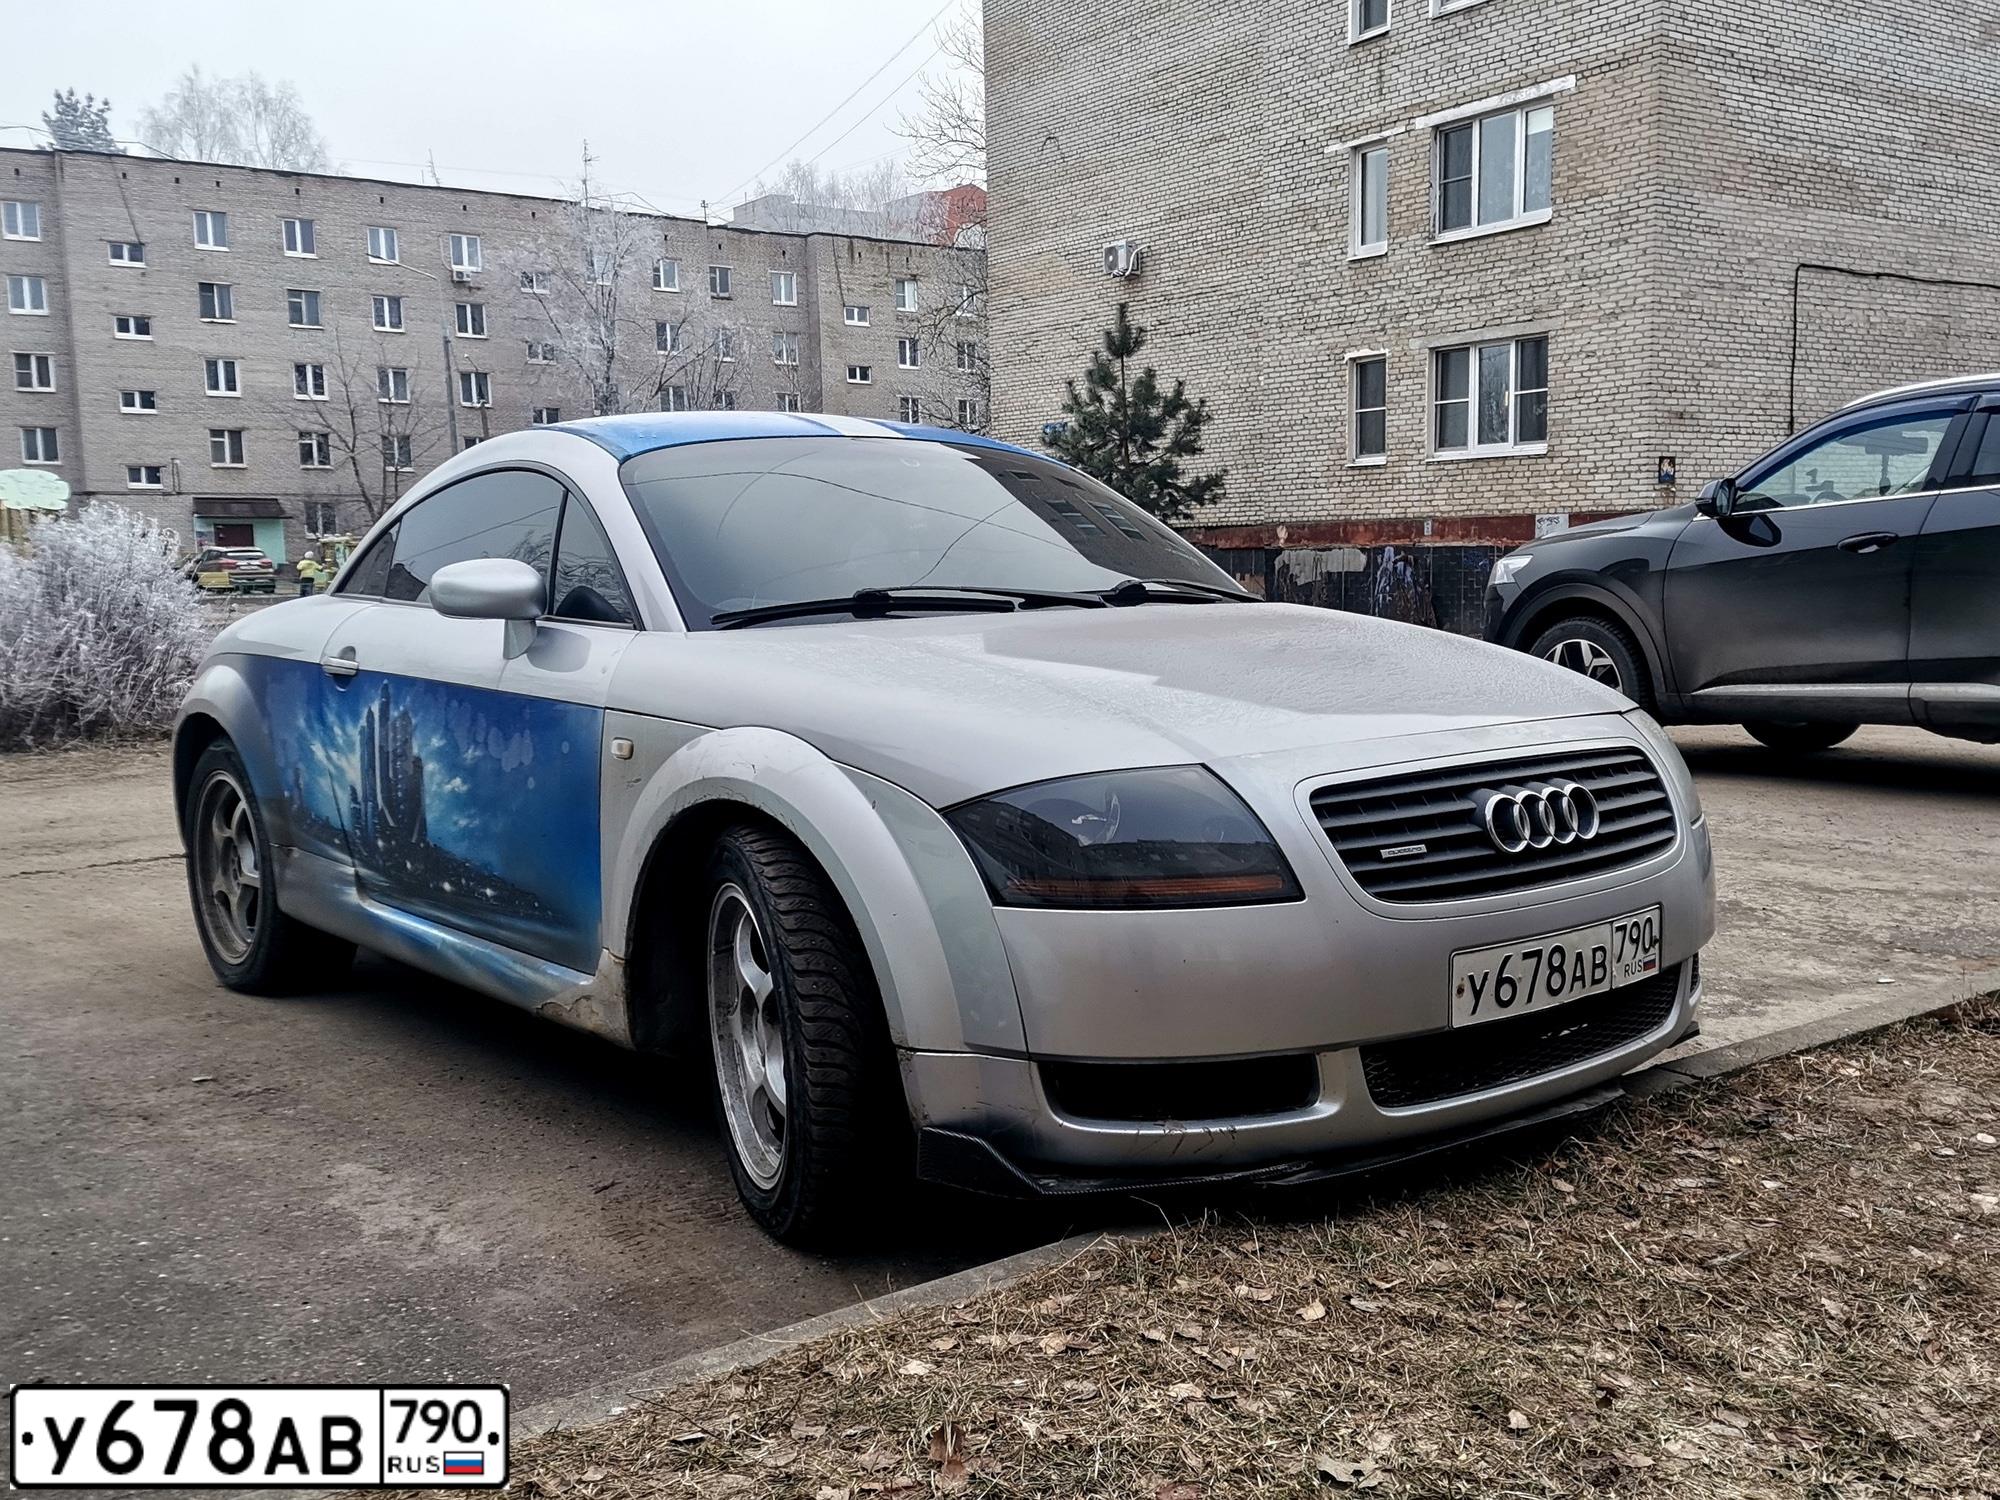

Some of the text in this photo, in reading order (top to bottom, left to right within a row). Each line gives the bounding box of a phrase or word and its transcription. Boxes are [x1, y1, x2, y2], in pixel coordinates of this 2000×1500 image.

[1614, 916, 1654, 964] 790
[1467, 944, 1608, 1016] У678АВ
[1624, 959, 1643, 978] RUS
